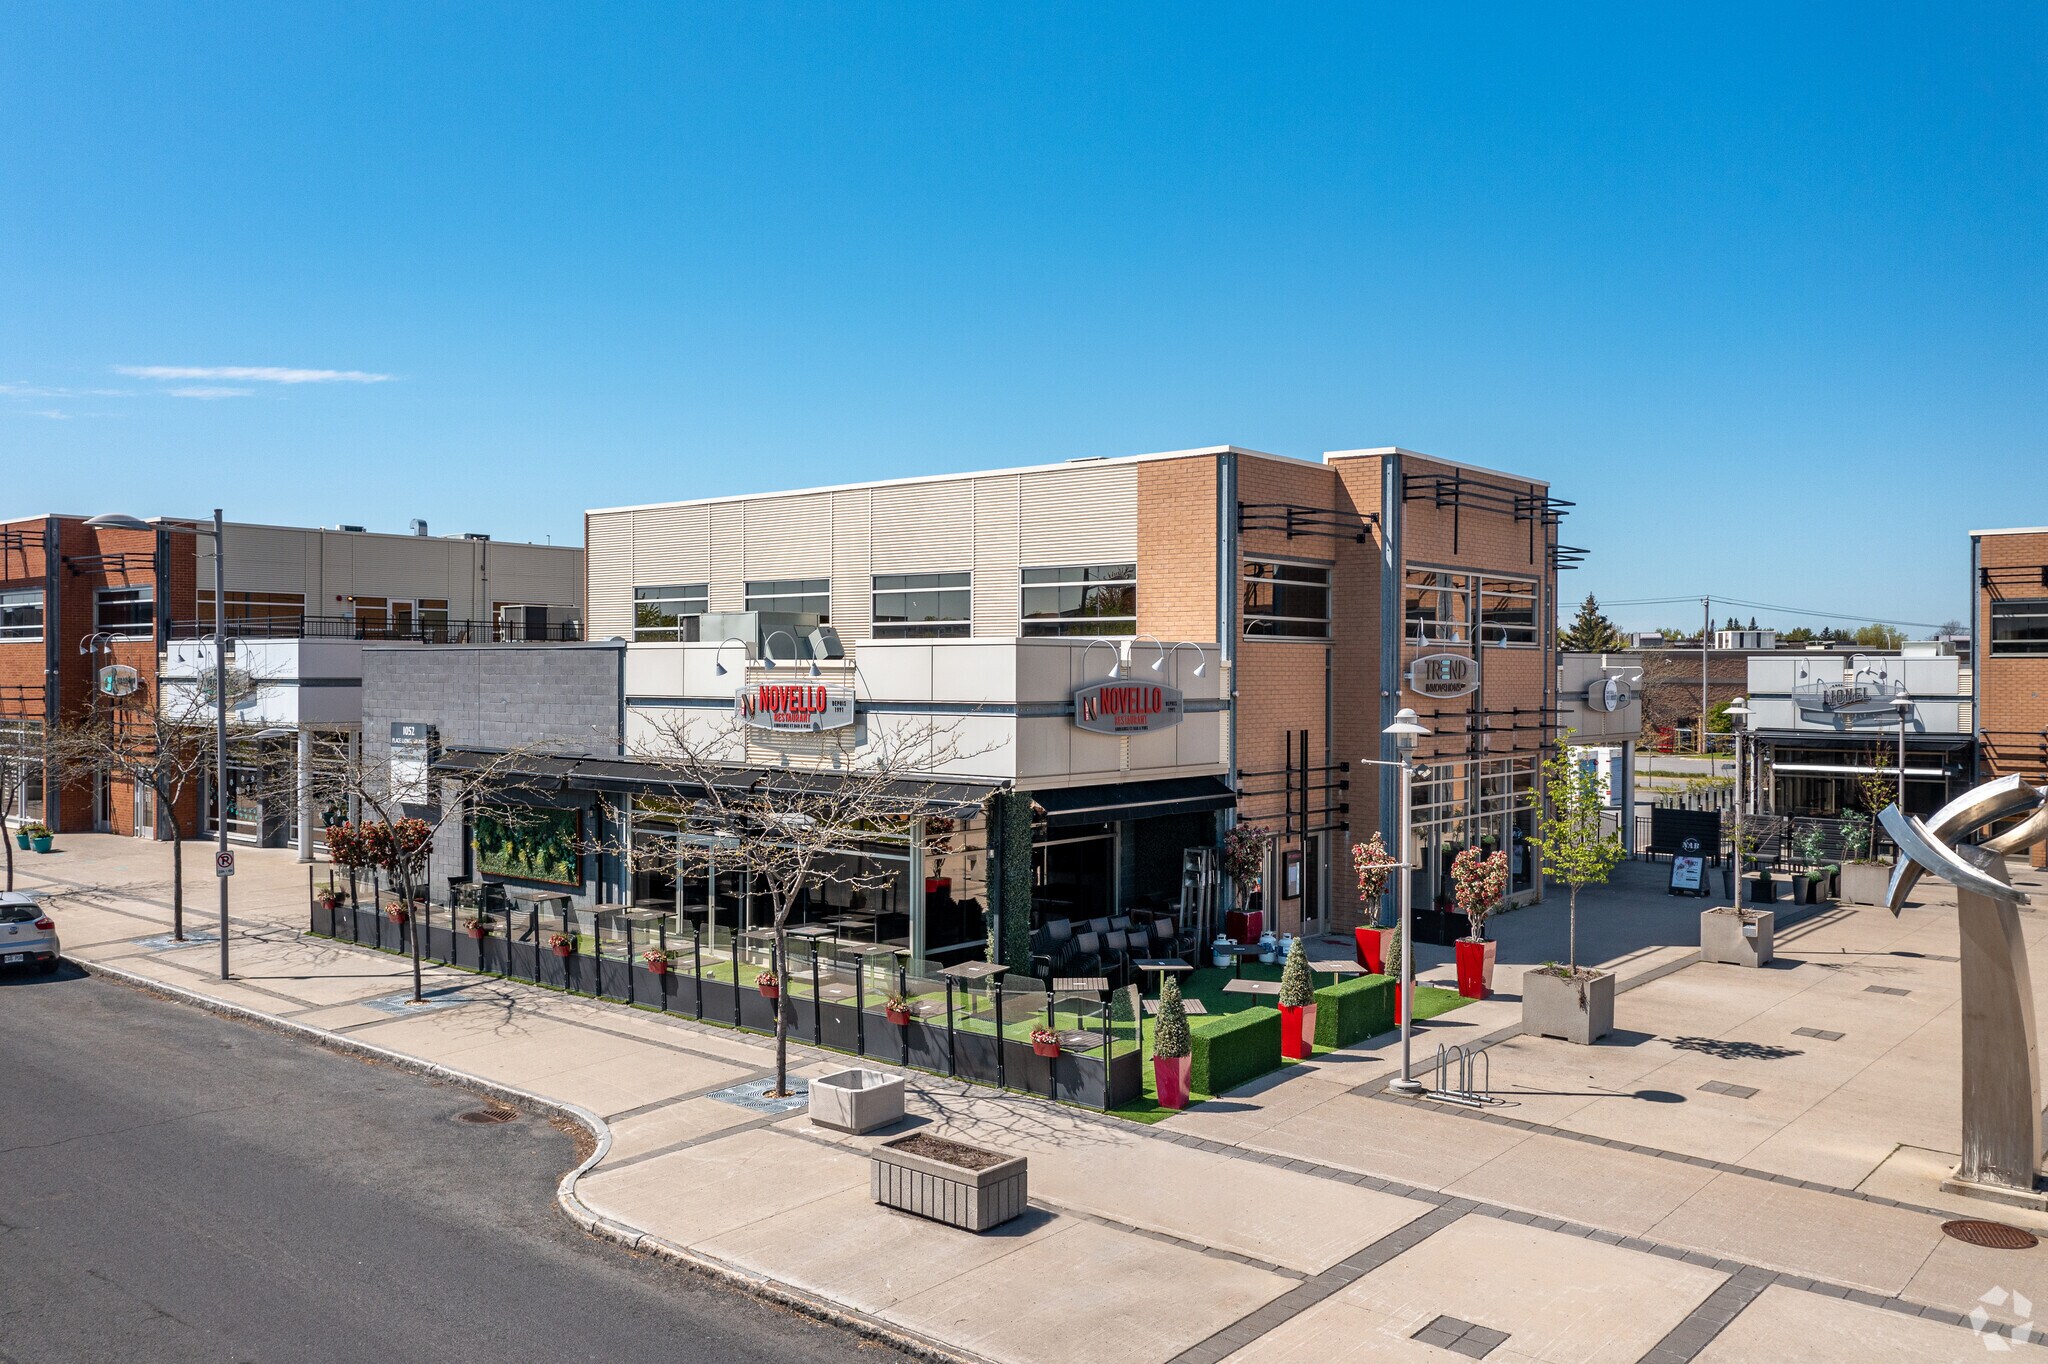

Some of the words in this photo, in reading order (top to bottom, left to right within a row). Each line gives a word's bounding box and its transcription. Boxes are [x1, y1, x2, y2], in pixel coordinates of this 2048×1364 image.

[1425, 660, 1467, 680] TREND
[760, 686, 827, 712] NOVELLO
[1101, 688, 1162, 714] NOVELLO
[774, 712, 811, 723] RESTAURANT
[1115, 716, 1148, 725] RESTAURANT
[403, 726, 415, 736] 1052
